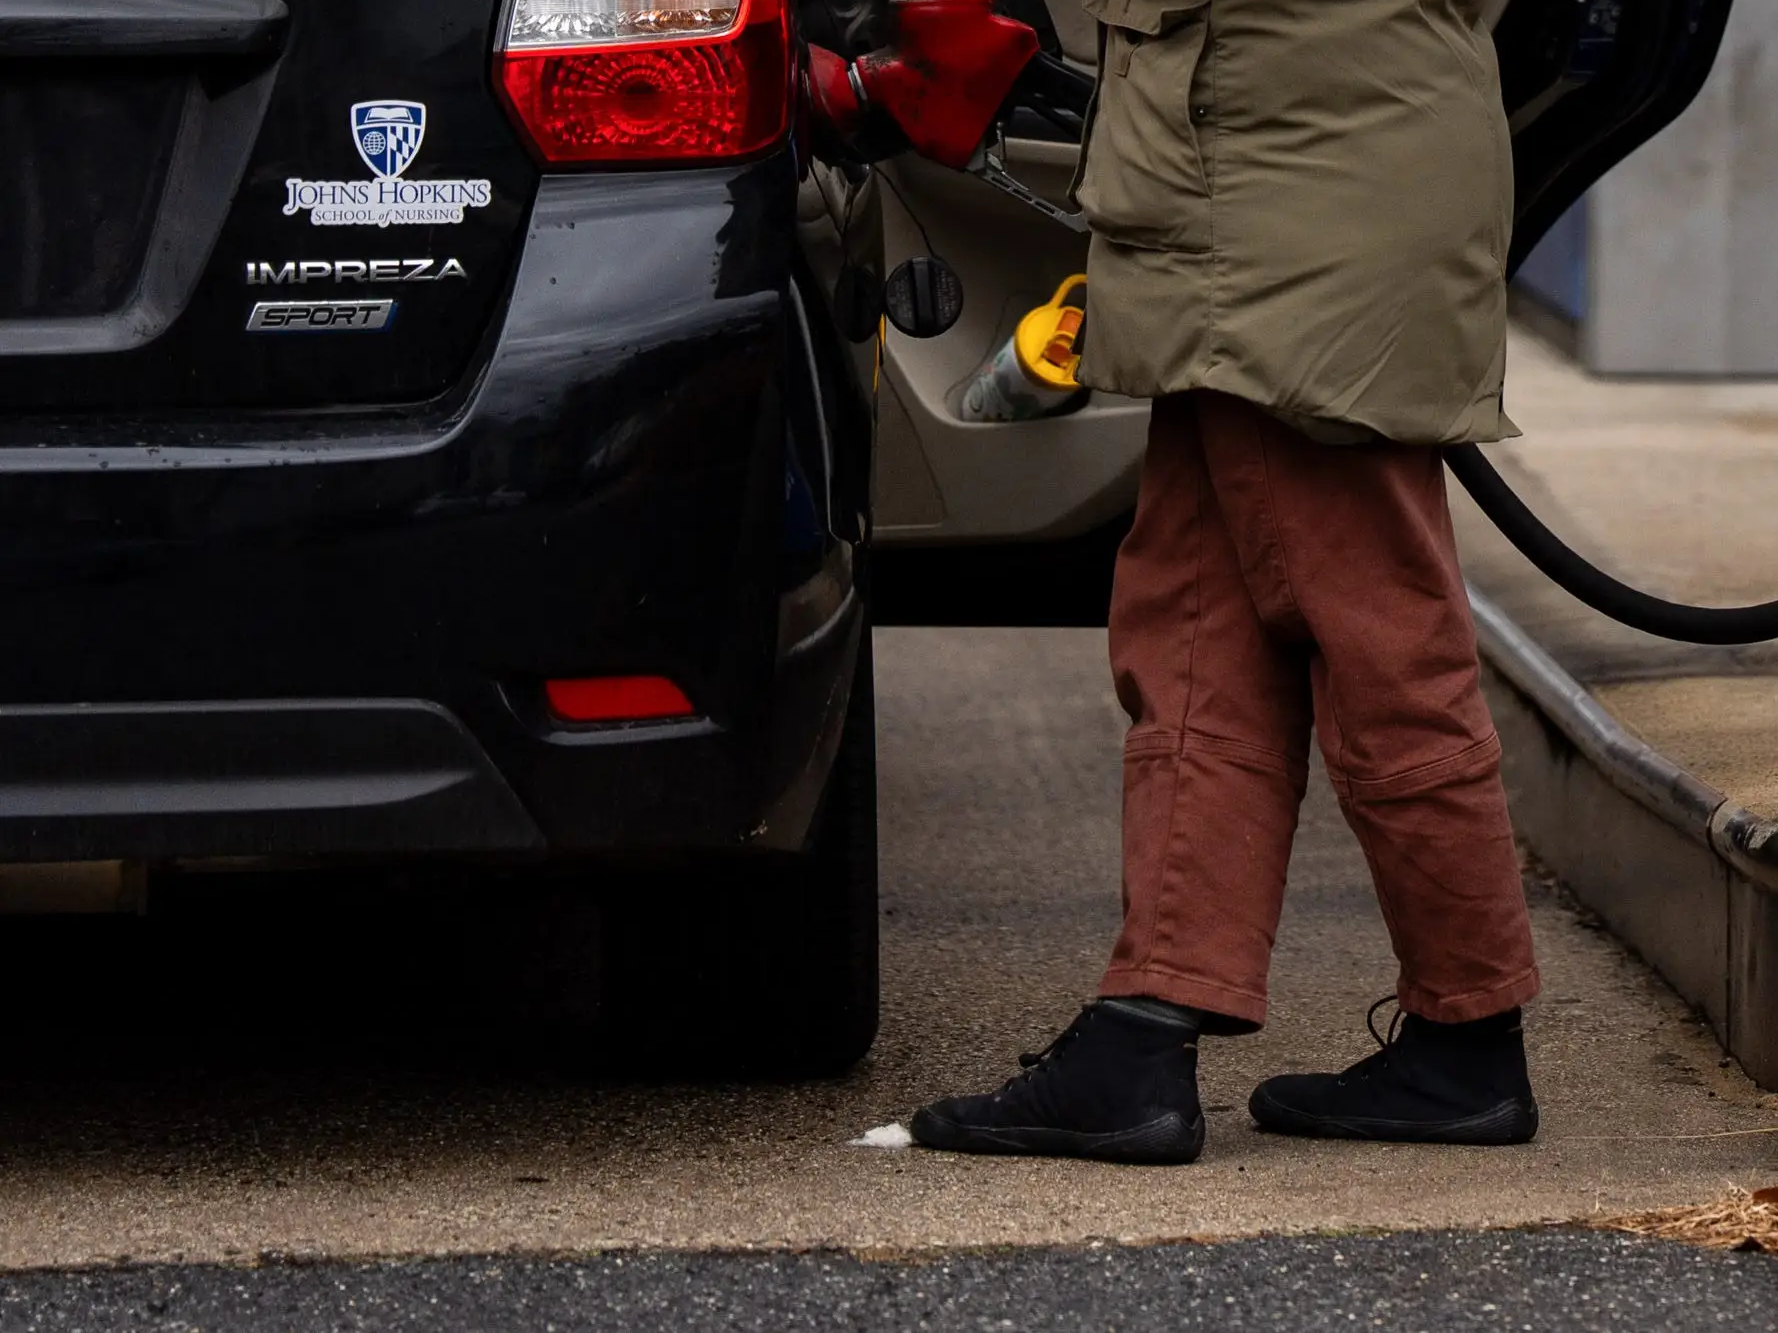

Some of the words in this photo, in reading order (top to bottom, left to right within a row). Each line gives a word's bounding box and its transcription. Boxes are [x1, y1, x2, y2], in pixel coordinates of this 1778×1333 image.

[287, 182, 369, 211] JOHNS
[377, 181, 489, 205] HOPKINS
[314, 209, 376, 222] SCHOOL
[378, 209, 393, 225] of
[395, 208, 461, 221] NURSING
[246, 258, 468, 285] IMPREZA
[261, 305, 382, 327] SPORT
